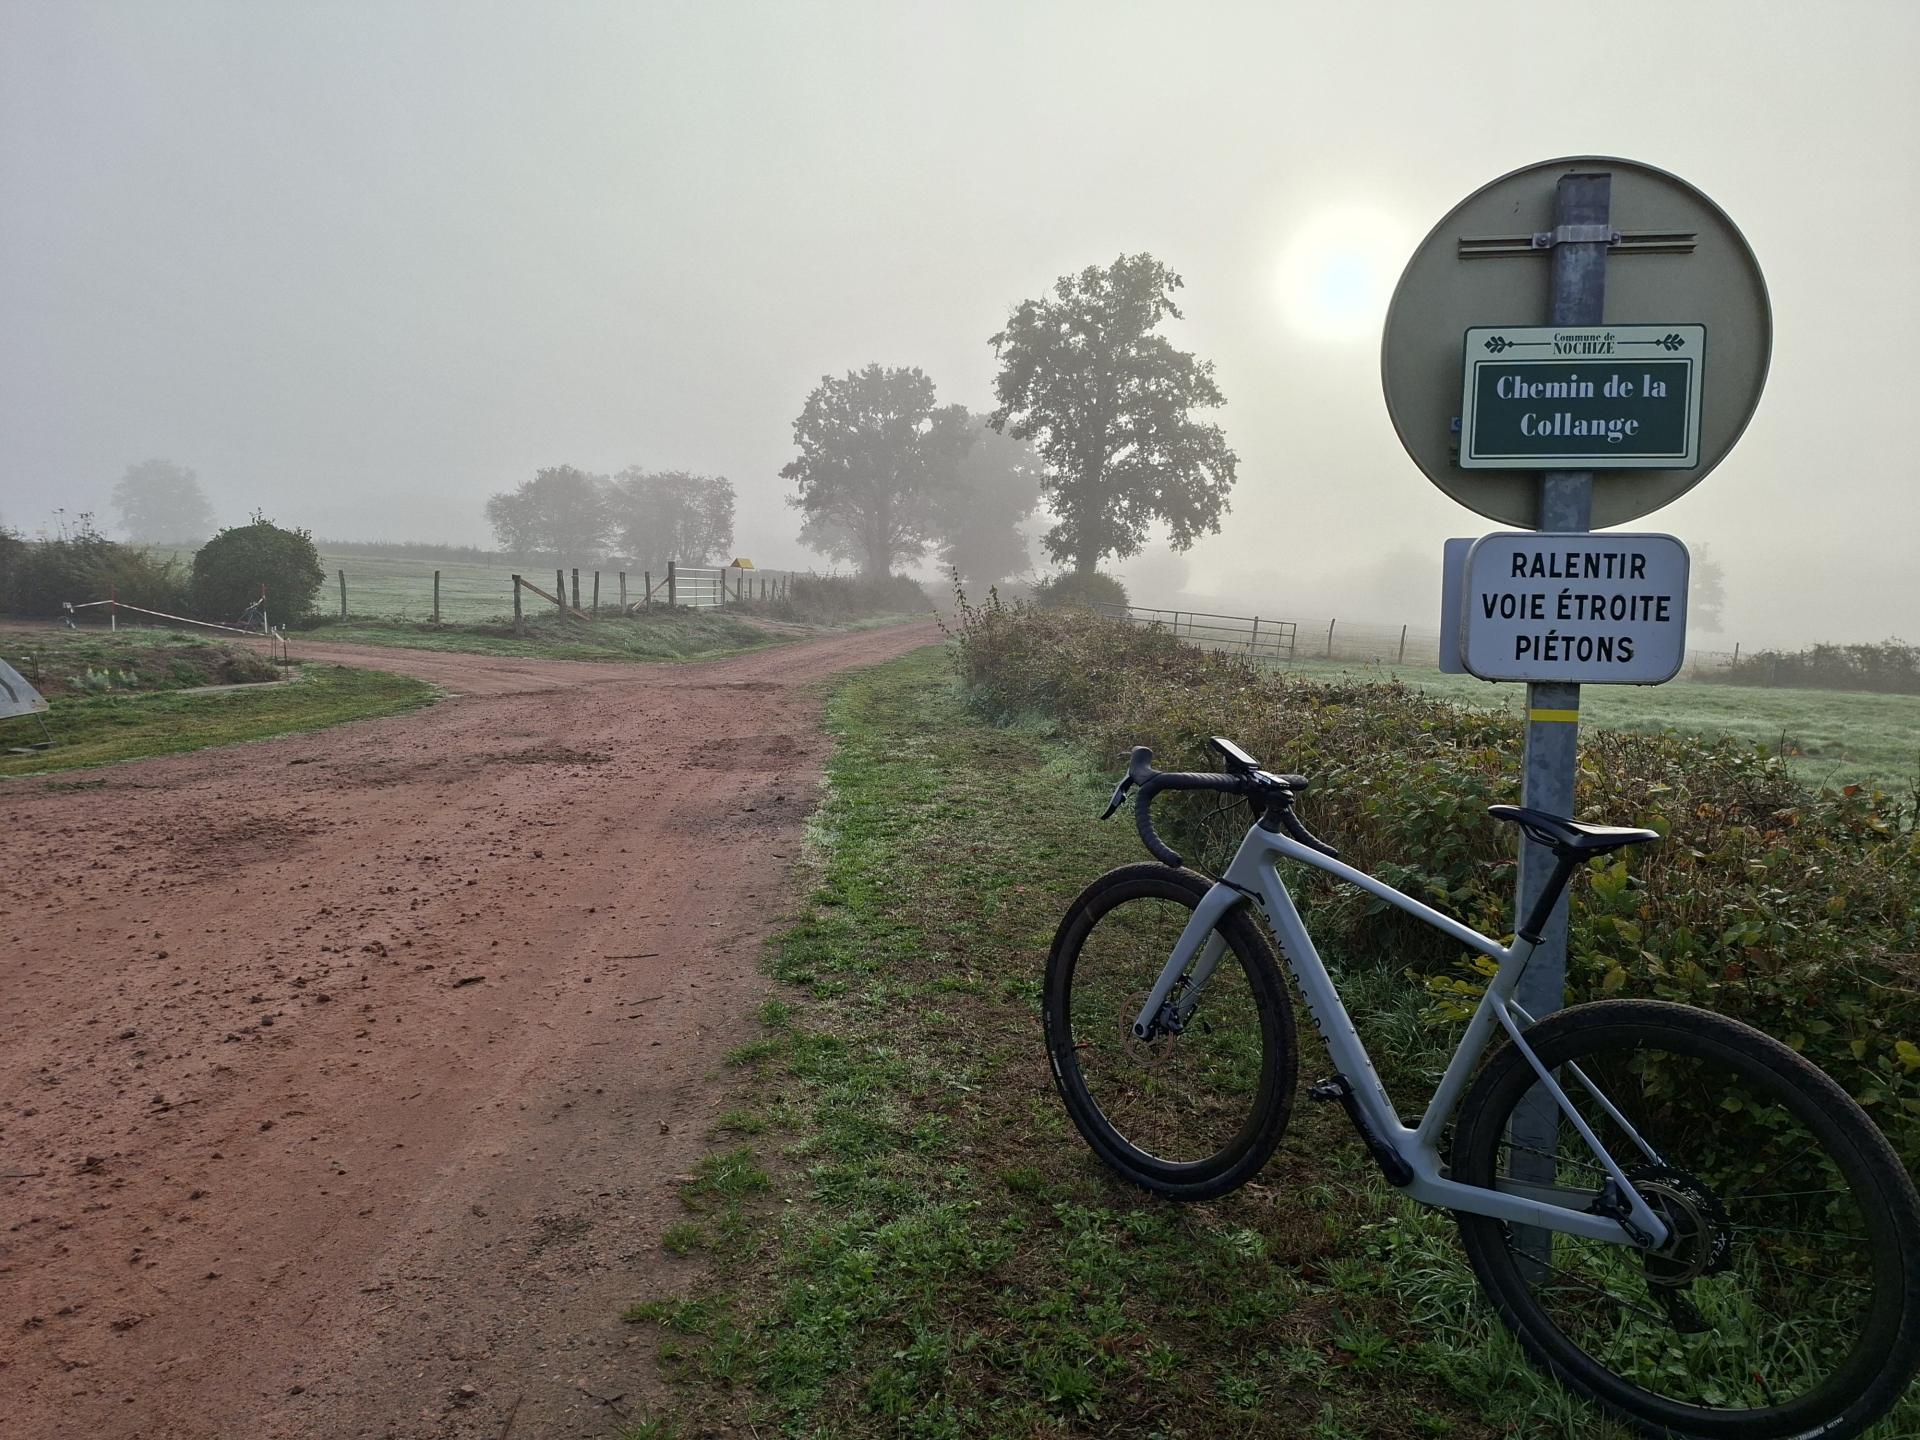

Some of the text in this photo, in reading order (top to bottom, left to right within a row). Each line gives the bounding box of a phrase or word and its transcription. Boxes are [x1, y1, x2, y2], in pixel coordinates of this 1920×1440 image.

[1552, 341, 1616, 355] NOCHIZE
[1554, 332, 1616, 342] Commune de
[1496, 374, 1667, 399] Chemin de la
[1520, 412, 1639, 443] Collange
[1511, 552, 1647, 580] RALENTIR
[1482, 588, 1672, 622] VOIE ÉTROITE
[1515, 629, 1635, 663] PIÉTONS
